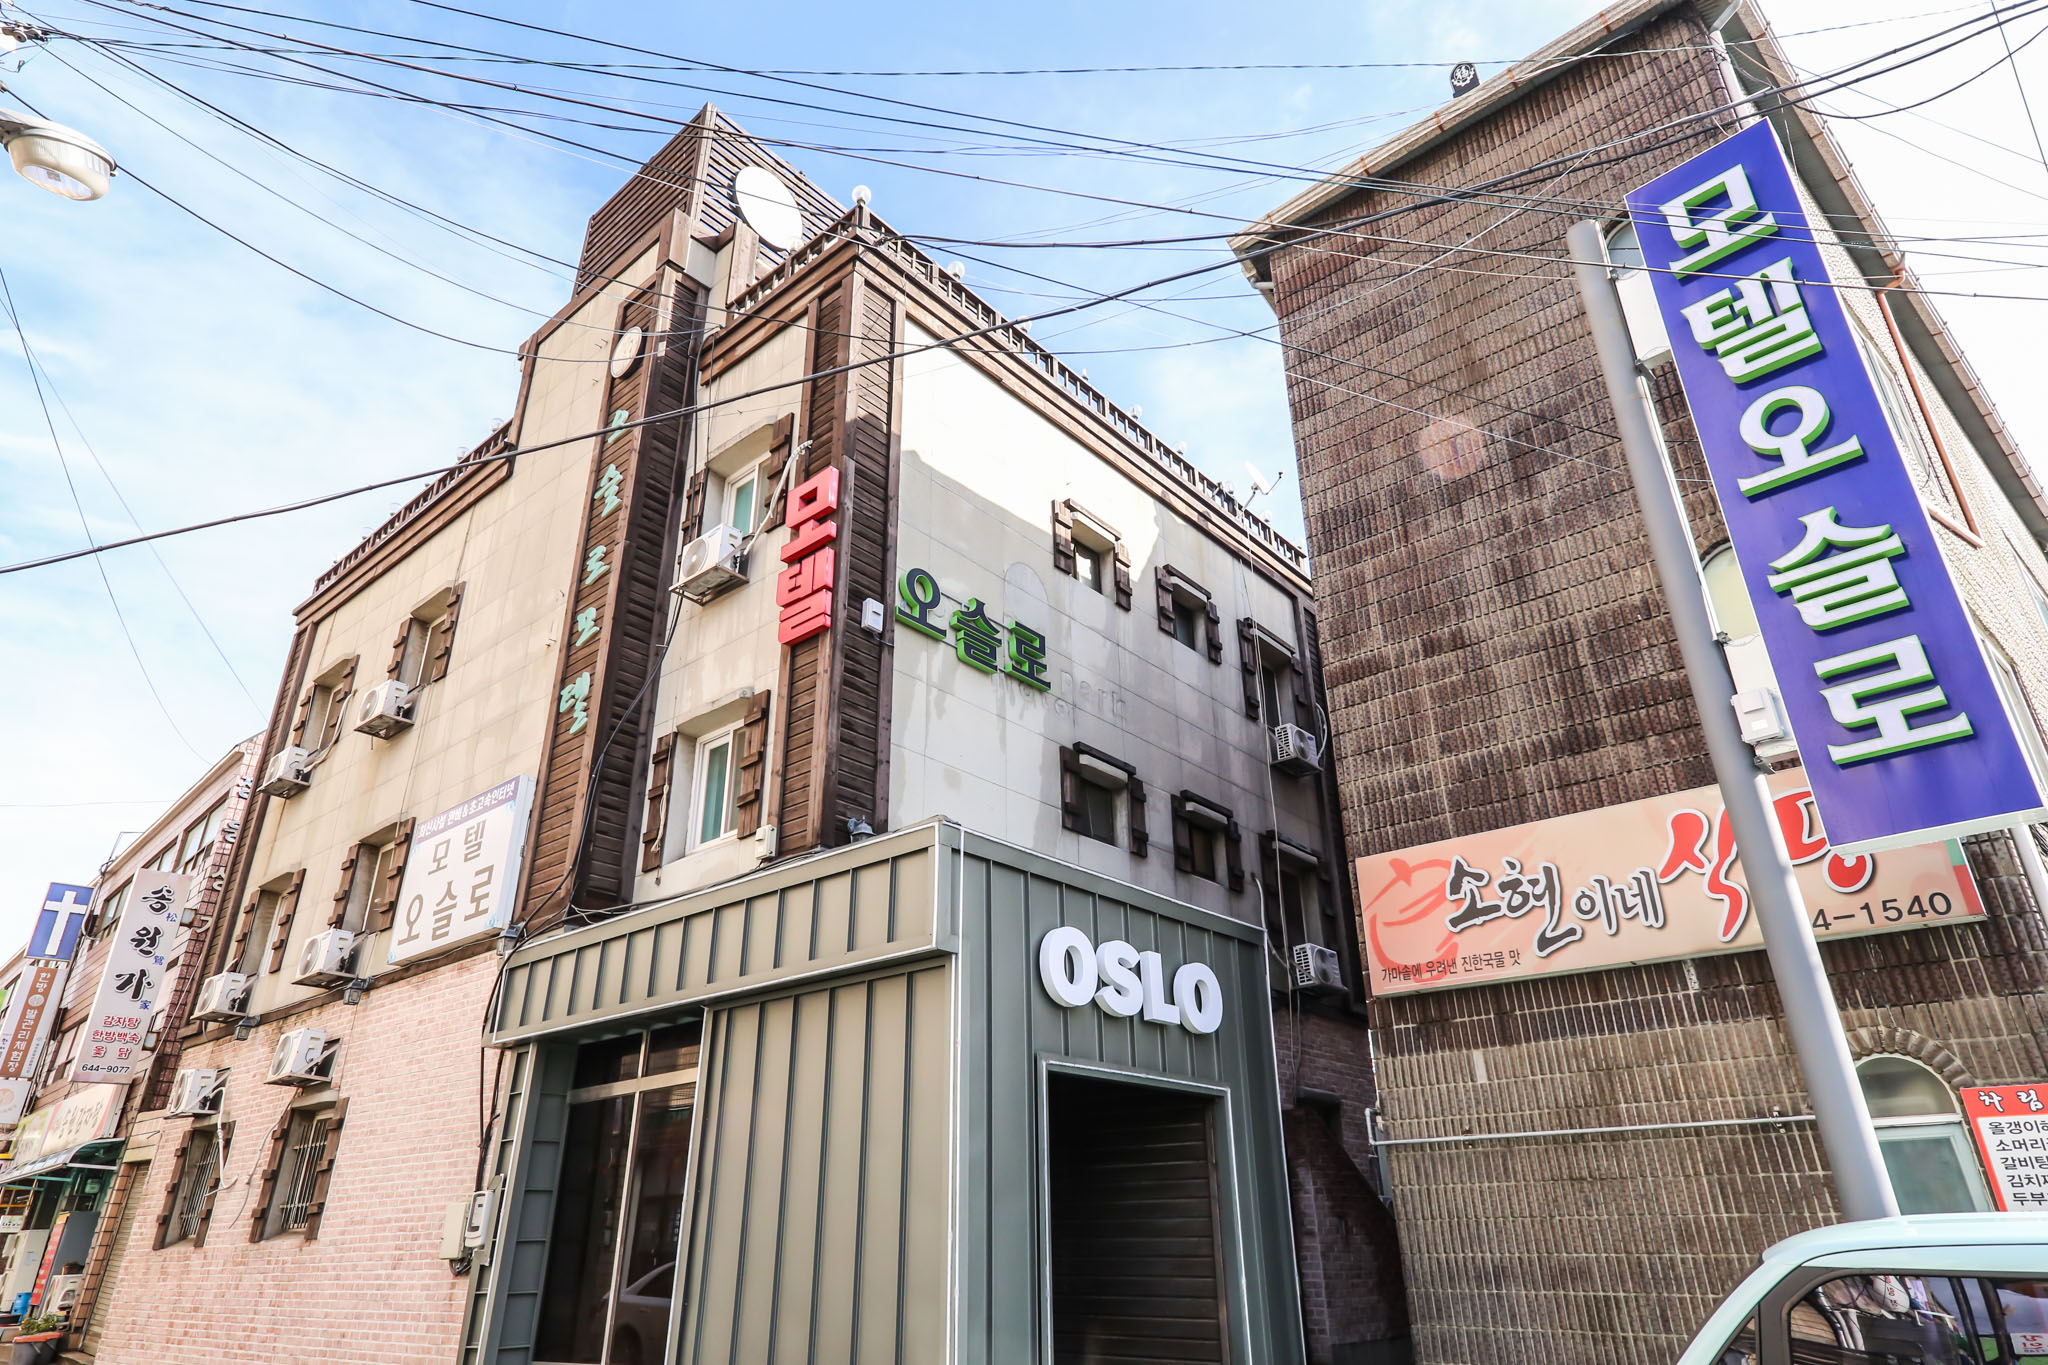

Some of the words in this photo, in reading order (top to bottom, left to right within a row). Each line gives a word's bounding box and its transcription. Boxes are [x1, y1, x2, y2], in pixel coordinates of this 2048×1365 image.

[776, 465, 840, 645] 모텔
[895, 567, 1051, 692] 오슬로
[397, 864, 495, 946] 오슬로
[1381, 963, 1423, 983] 가마솥에
[1426, 957, 1458, 977] 우려낸
[1461, 951, 1505, 973] 진한국물
[1508, 949, 1521, 967] 맛
[36, 971, 50, 993] 한방
[1039, 926, 1223, 1034] OSLO
[103, 1015, 139, 1028] 감자탕
[92, 1029, 140, 1043] 한방백숙
[81, 1063, 130, 1074] 644-9077
[1996, 1137, 2048, 1152] 소머리
[2012, 1192, 2048, 1206] 두부
